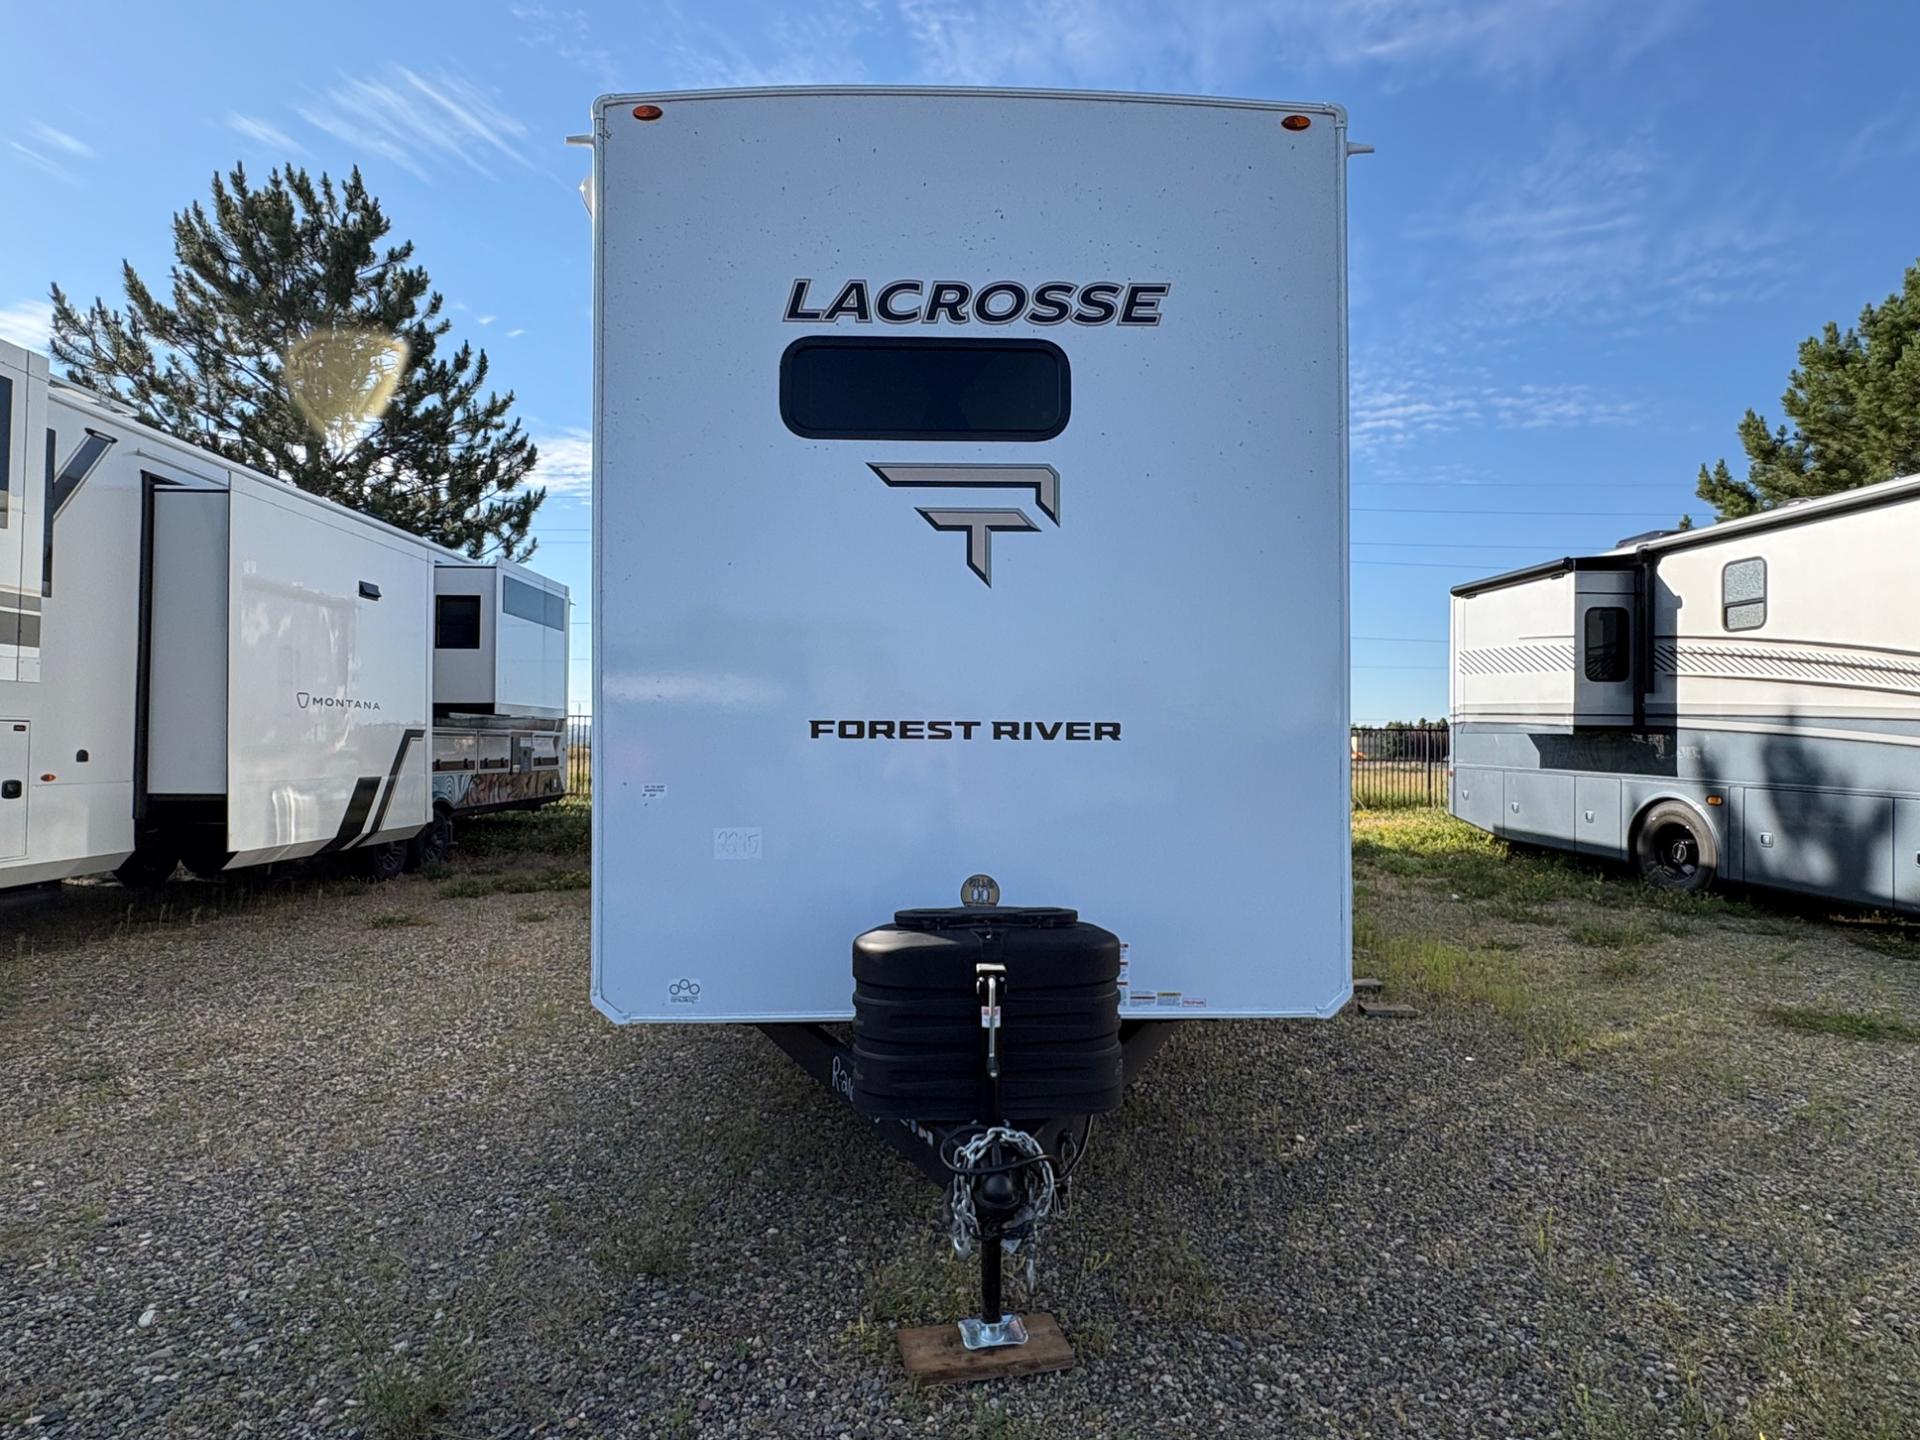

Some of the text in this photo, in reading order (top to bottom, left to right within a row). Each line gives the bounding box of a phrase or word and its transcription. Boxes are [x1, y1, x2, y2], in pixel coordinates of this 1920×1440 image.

[782, 278, 1171, 326] LACROSSE
[312, 697, 381, 710] MONTANA
[808, 720, 1122, 742] FOREST RIVER
